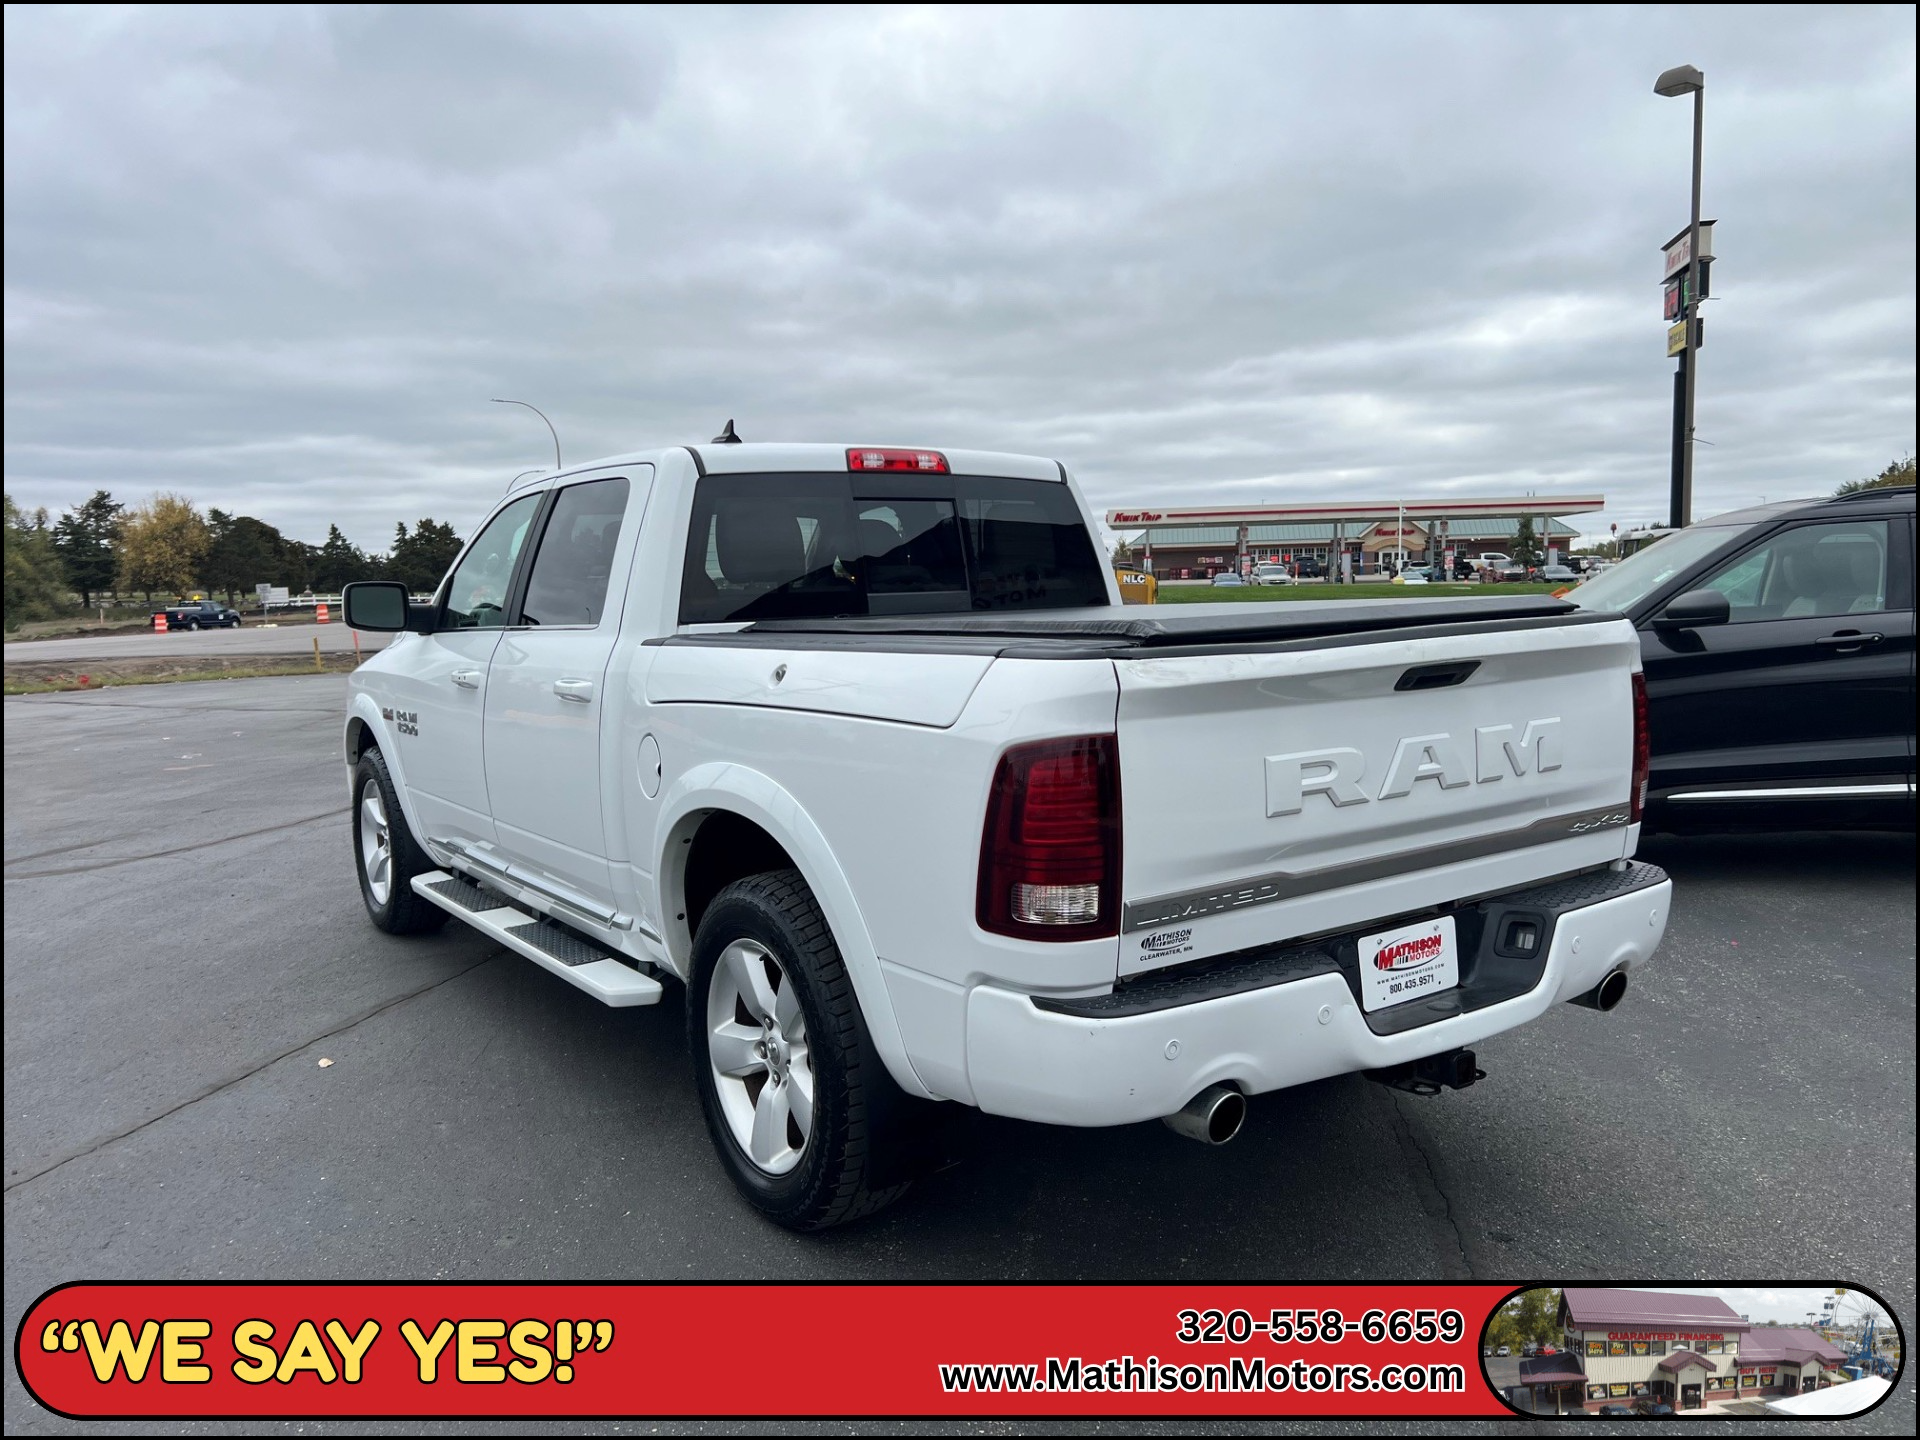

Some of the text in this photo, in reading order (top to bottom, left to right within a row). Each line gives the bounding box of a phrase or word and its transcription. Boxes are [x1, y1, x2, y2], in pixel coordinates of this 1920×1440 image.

[1123, 574, 1146, 583] NLC
[1264, 717, 1562, 818] RAM
[1136, 884, 1279, 925] LIMITED
[1143, 928, 1192, 949] MATHISON
[1166, 936, 1190, 947] MOTORS
[1183, 945, 1193, 953] MN
[1378, 934, 1442, 970] MATHISON
[1409, 947, 1440, 961] MOTORS
[1389, 974, 1434, 994] 800.435.9571
[1608, 1332, 1724, 1341] GUARANTEED FINANCING
